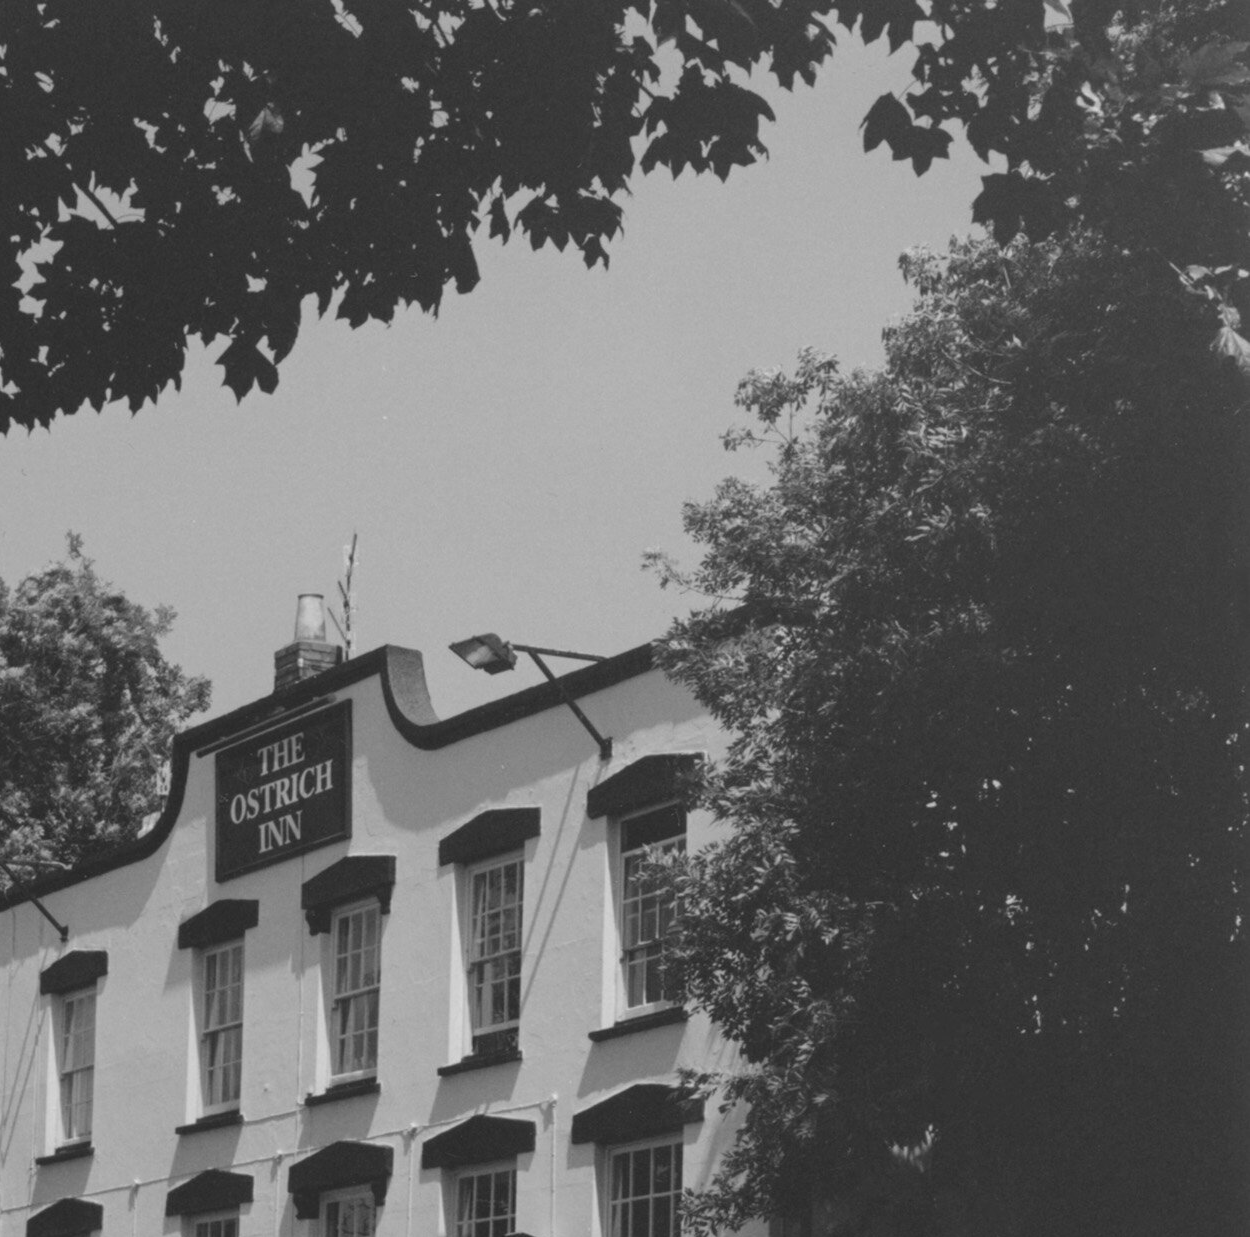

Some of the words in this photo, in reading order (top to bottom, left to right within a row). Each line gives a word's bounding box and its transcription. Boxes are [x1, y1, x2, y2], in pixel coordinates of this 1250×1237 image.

[257, 732, 305, 777] THE
[230, 759, 334, 825] OSTRICH
[258, 810, 303, 854] INN
